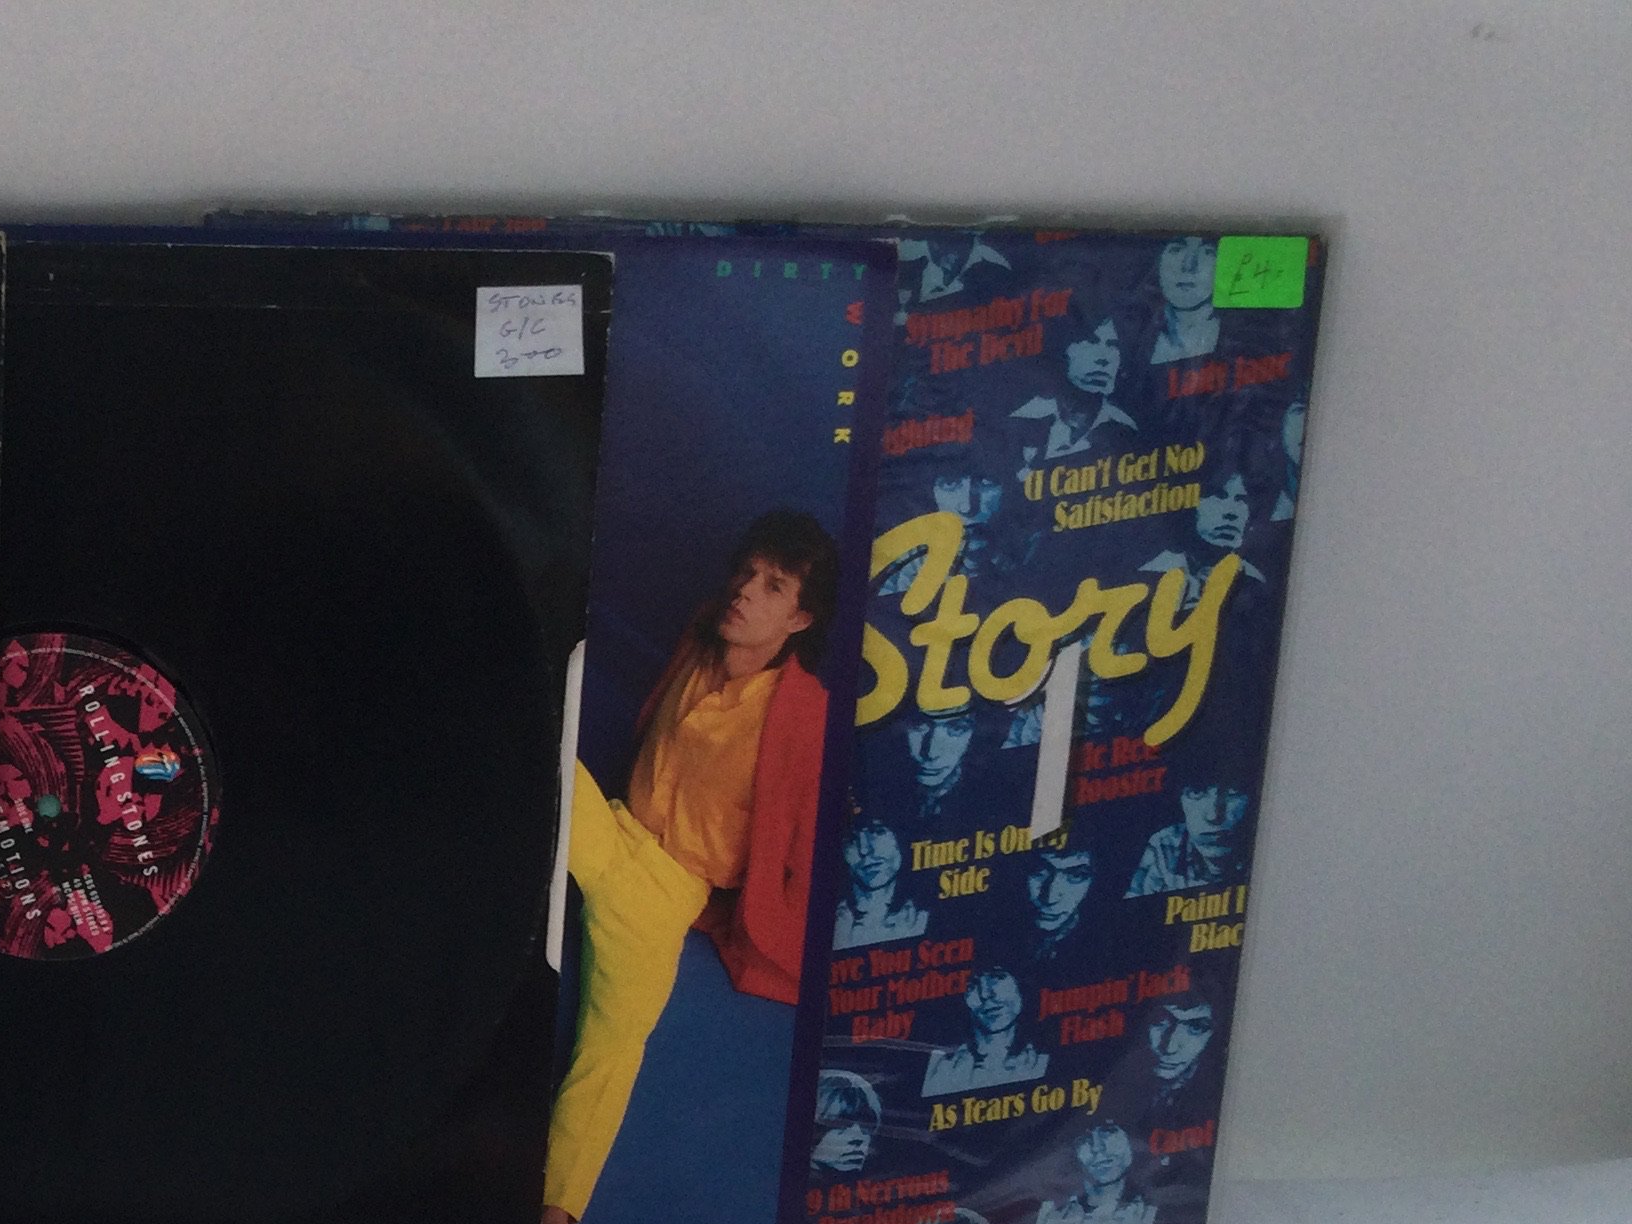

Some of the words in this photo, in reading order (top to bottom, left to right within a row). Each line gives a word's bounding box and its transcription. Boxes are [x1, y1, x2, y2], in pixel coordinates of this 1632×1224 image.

[716, 259, 867, 281] DIRTY
[832, 300, 866, 444] WORK
[1049, 455, 1112, 497] Can't
[1117, 447, 1160, 485] Get
[1163, 440, 1206, 477] No)
[1052, 482, 1201, 532] Satisfaction
[79, 684, 126, 784] ROLLING
[116, 791, 159, 878] STONES
[911, 840, 970, 872] Time
[974, 831, 996, 860] Is
[938, 866, 991, 900] Side
[1164, 886, 1233, 925] Paint
[928, 1103, 958, 1132] As
[962, 1089, 1025, 1127] Tears
[1031, 1083, 1066, 1115] Go
[1070, 1077, 1104, 1115] By
